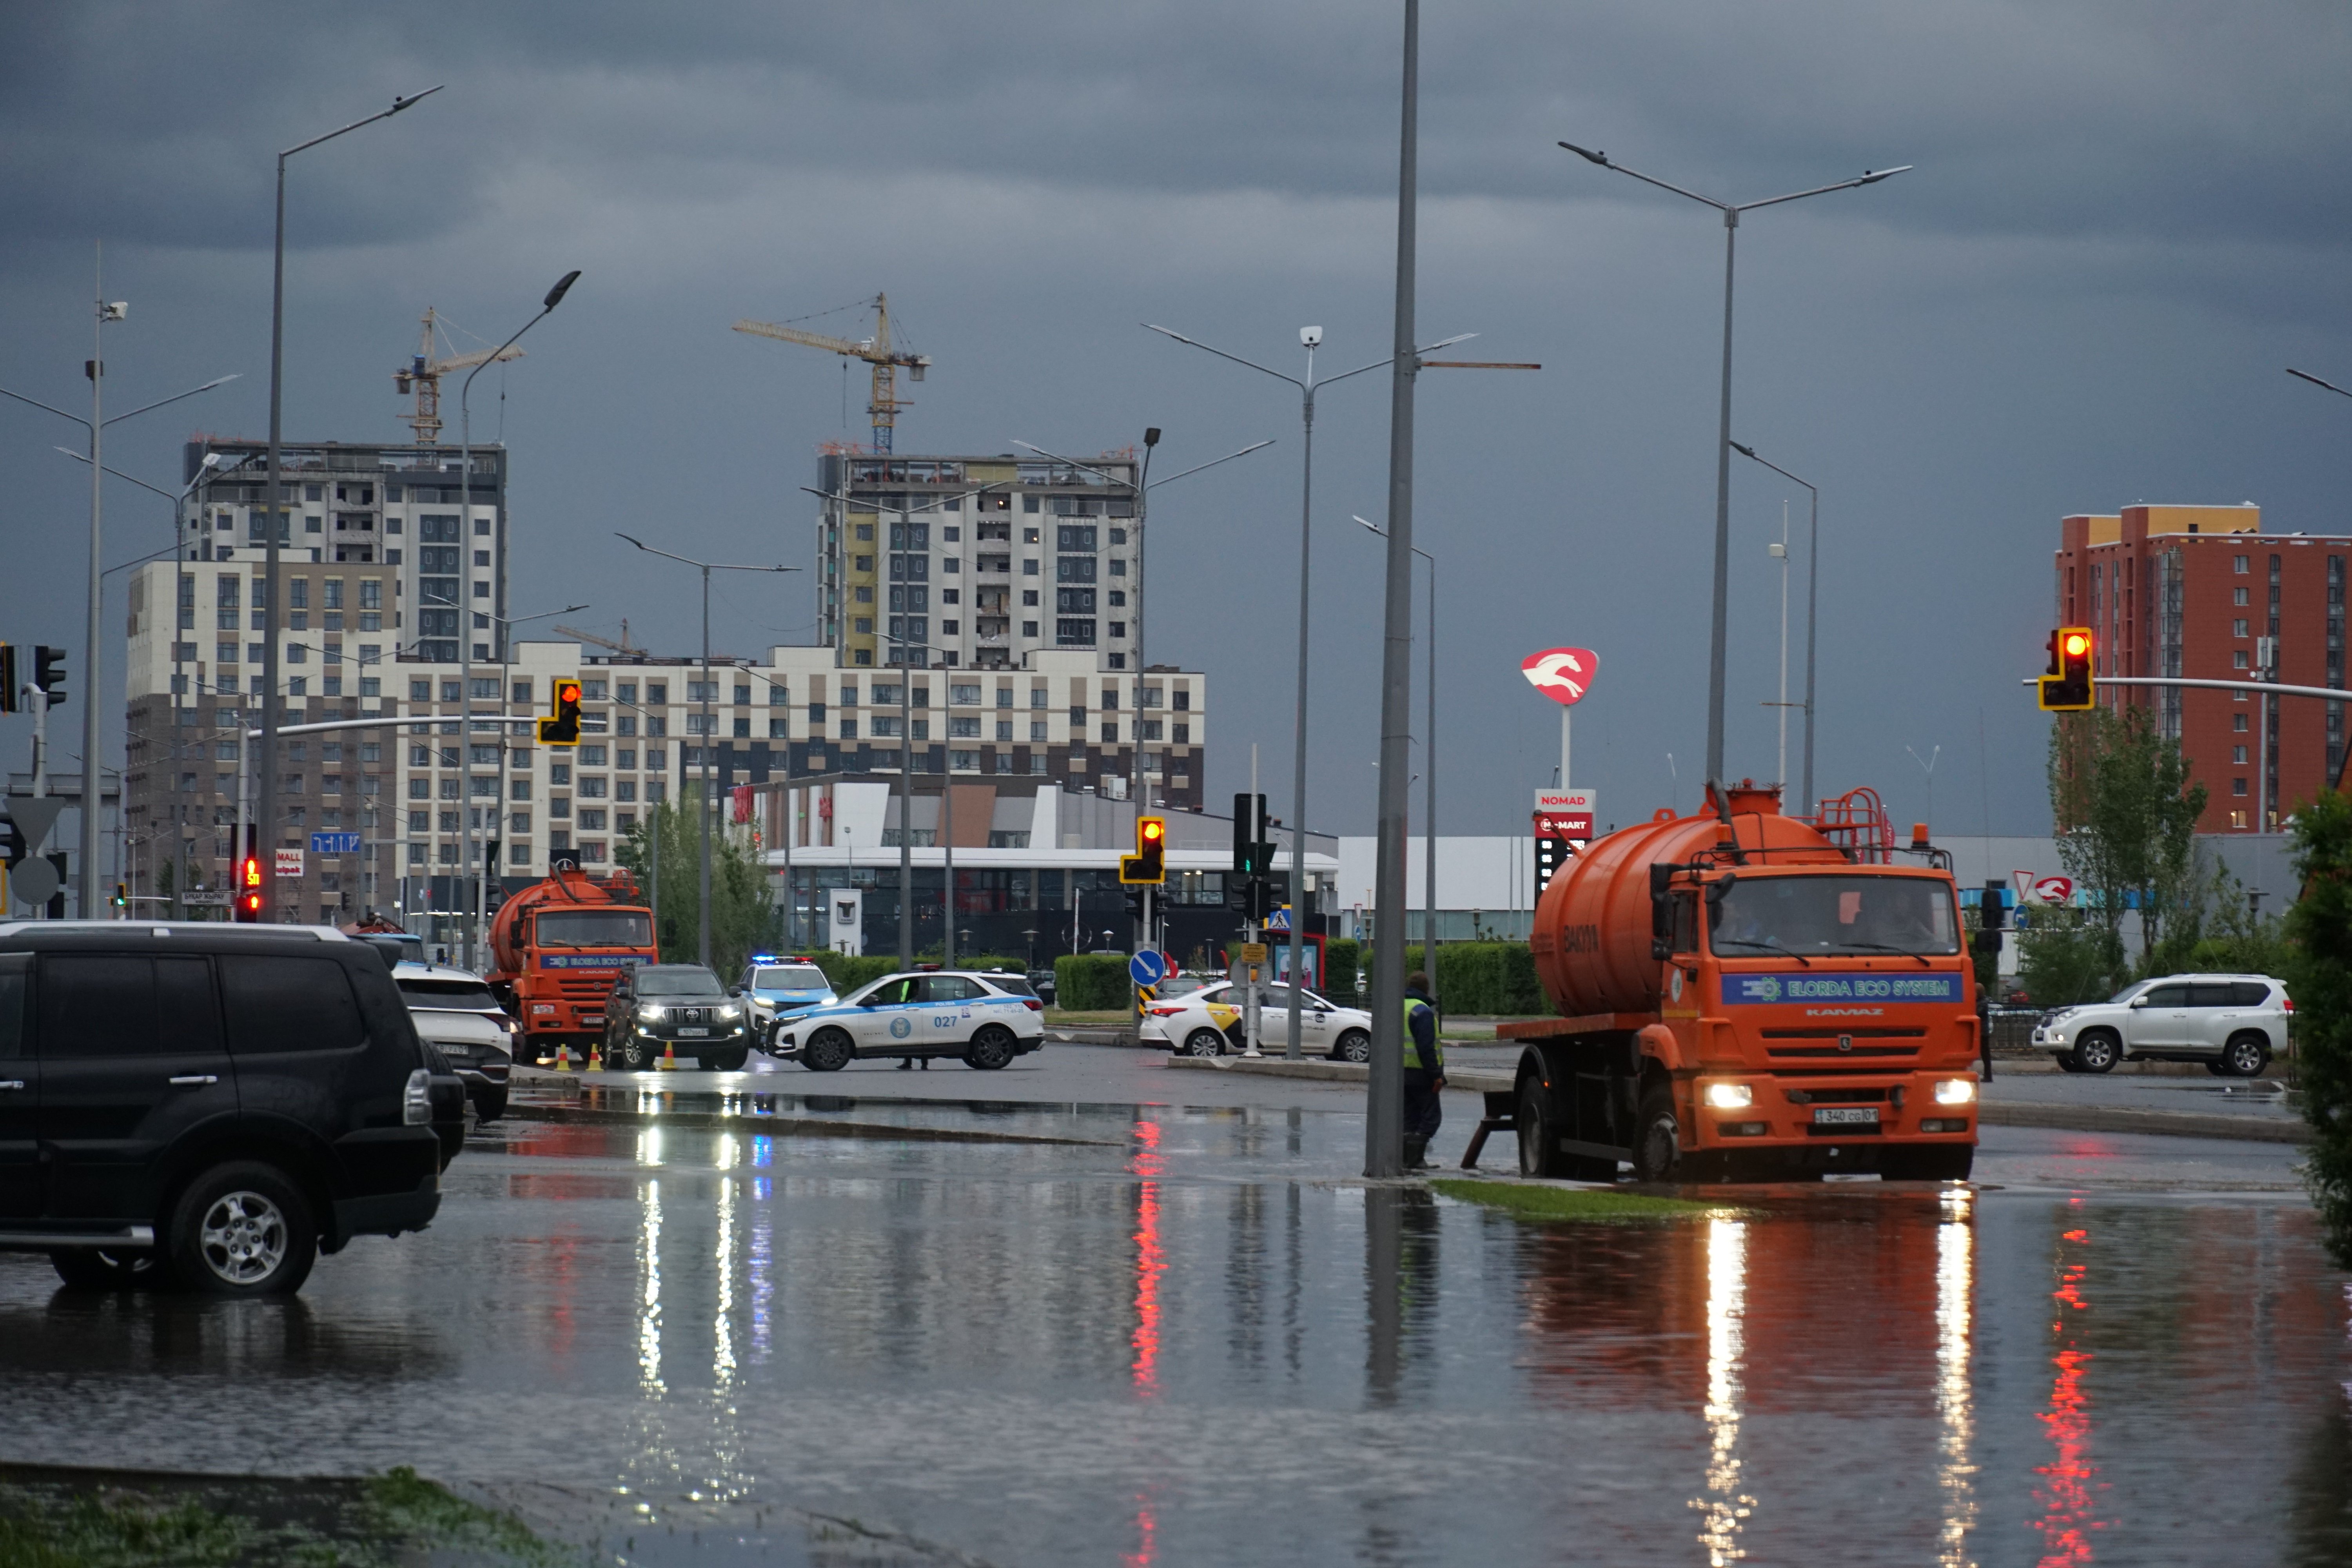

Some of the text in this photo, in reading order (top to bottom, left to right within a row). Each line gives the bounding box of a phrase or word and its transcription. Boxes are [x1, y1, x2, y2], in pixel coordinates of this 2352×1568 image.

[1541, 797, 1586, 805] NOMAD
[277, 853, 301, 861] MALL
[276, 866, 301, 874] ulpak
[939, 903, 968, 916] Sar
[1788, 980, 1950, 996] ELORDA ECO SYSTEM
[934, 1016, 957, 1027] 027
[1826, 1111, 1845, 1121] 340
[1866, 1110, 1878, 1120] 01
